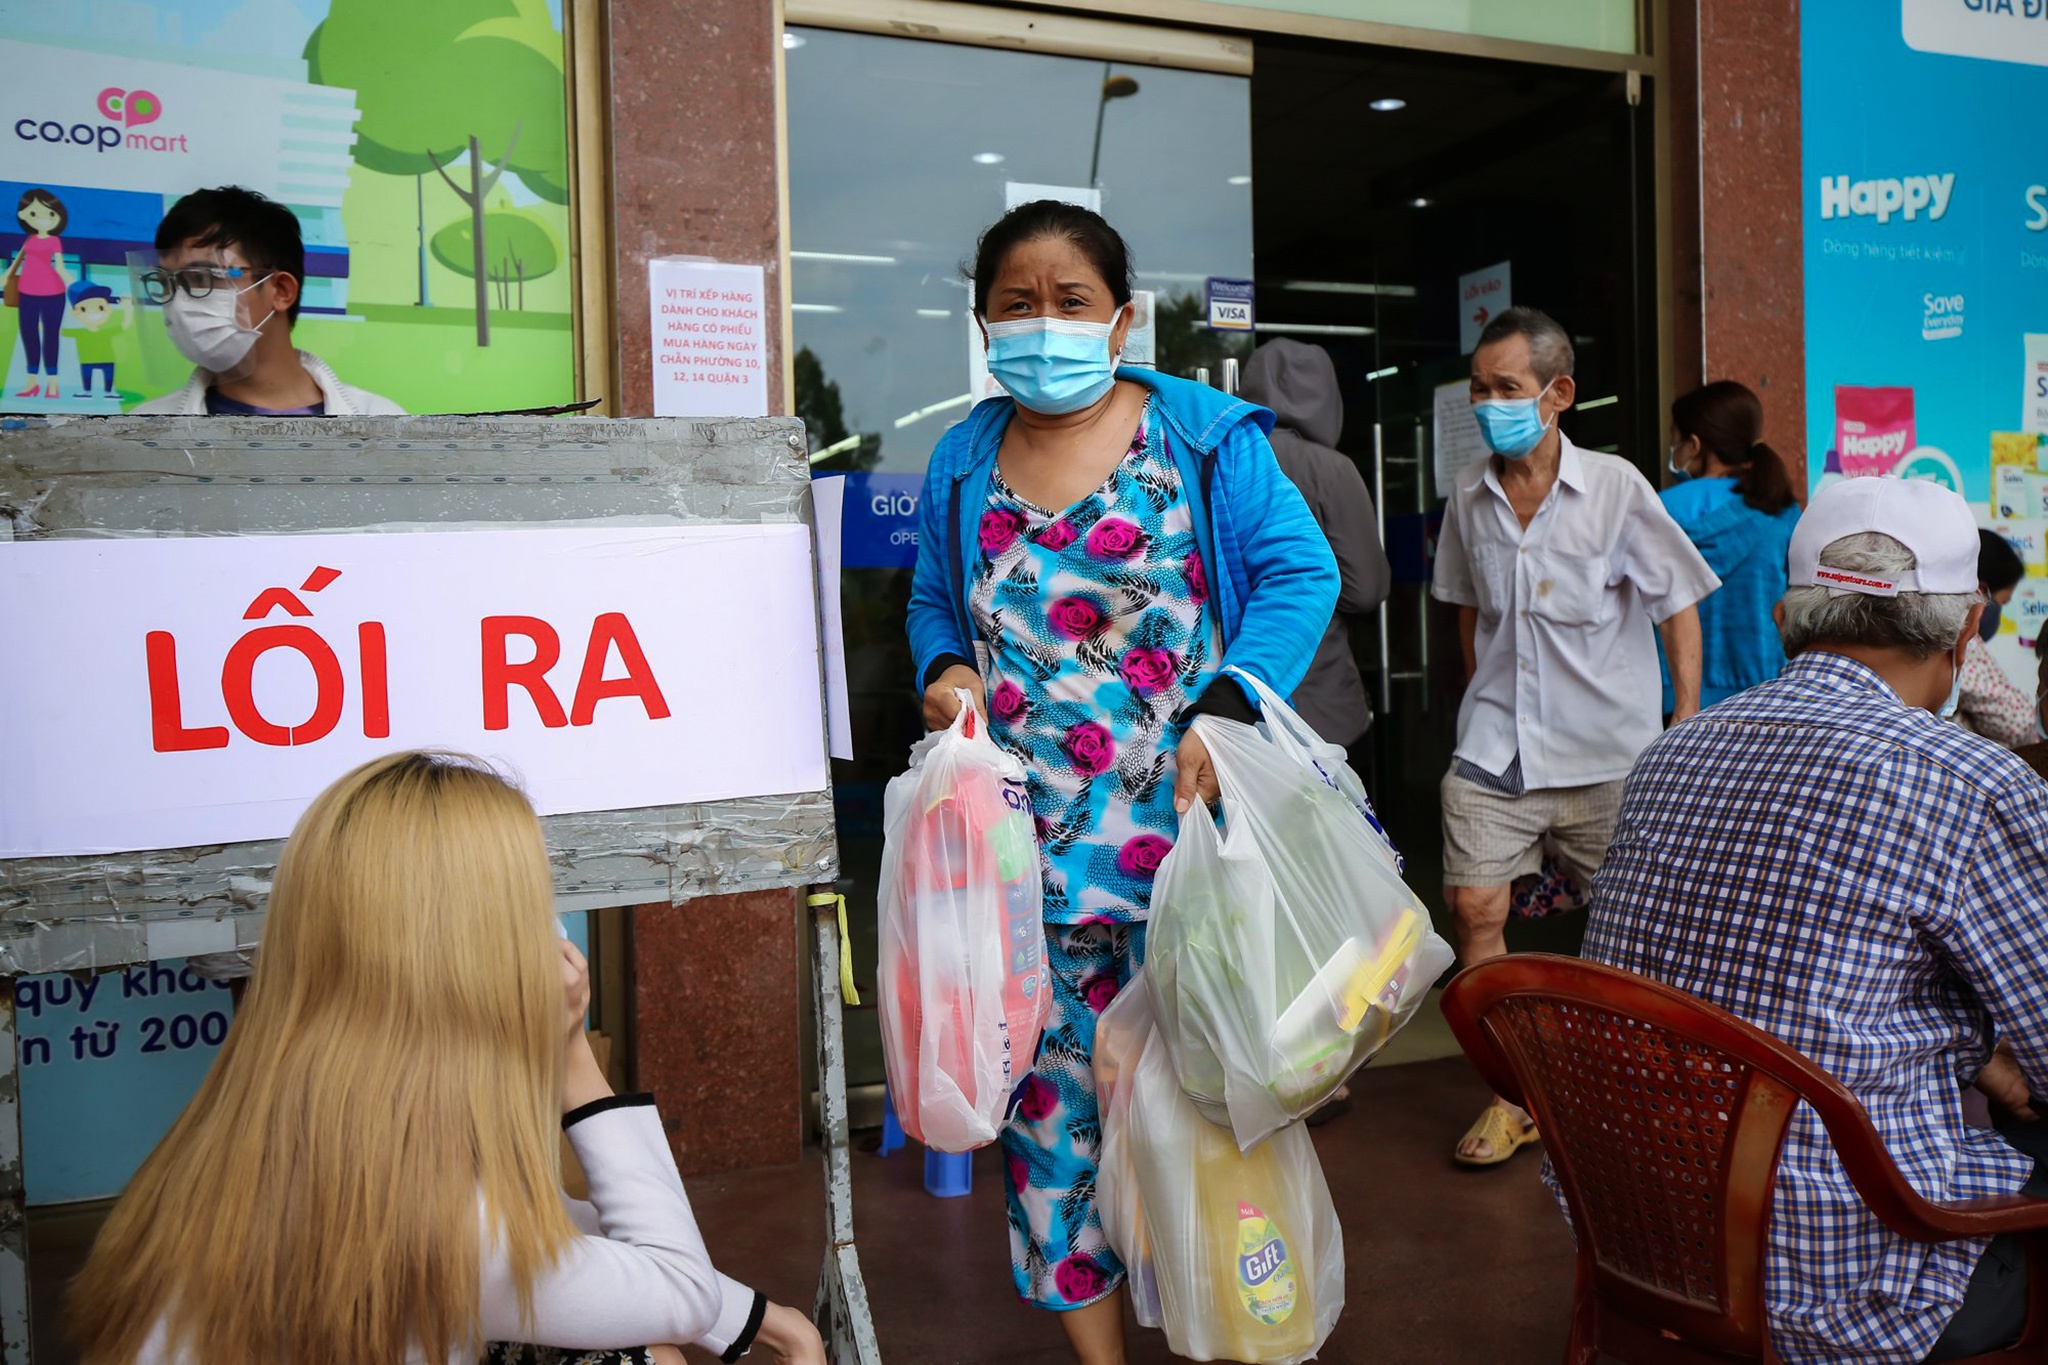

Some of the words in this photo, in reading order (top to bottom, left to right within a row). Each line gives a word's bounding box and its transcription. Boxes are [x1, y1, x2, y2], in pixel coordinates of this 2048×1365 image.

[1821, 173, 1956, 224] Happy
[665, 288, 677, 299] VỊ
[680, 287, 697, 299] TRÍ
[699, 288, 719, 300] XẾP
[721, 290, 753, 303] HÀNG
[1923, 293, 1964, 316] Save
[661, 303, 693, 316] DÀNH
[696, 307, 719, 317] CHO
[721, 307, 758, 319] KHÁCH
[1217, 306, 1246, 320] VISA
[667, 320, 700, 333] HÀNG
[702, 321, 717, 333] CÓ
[663, 338, 690, 348] MUA
[693, 338, 725, 350] HÀNG
[727, 339, 757, 352] NGÀY
[745, 359, 761, 369] 10,
[673, 371, 689, 382] 12,
[692, 372, 705, 382] 14
[707, 371, 740, 385] QUẬN
[742, 375, 749, 384] 3
[1843, 429, 1907, 459] Happy
[871, 495, 918, 517] GIỜ
[146, 566, 390, 752] LỐI
[481, 612, 672, 730] RA
[69, 1021, 120, 1061] từ
[1245, 1242, 1281, 1281] Gift
